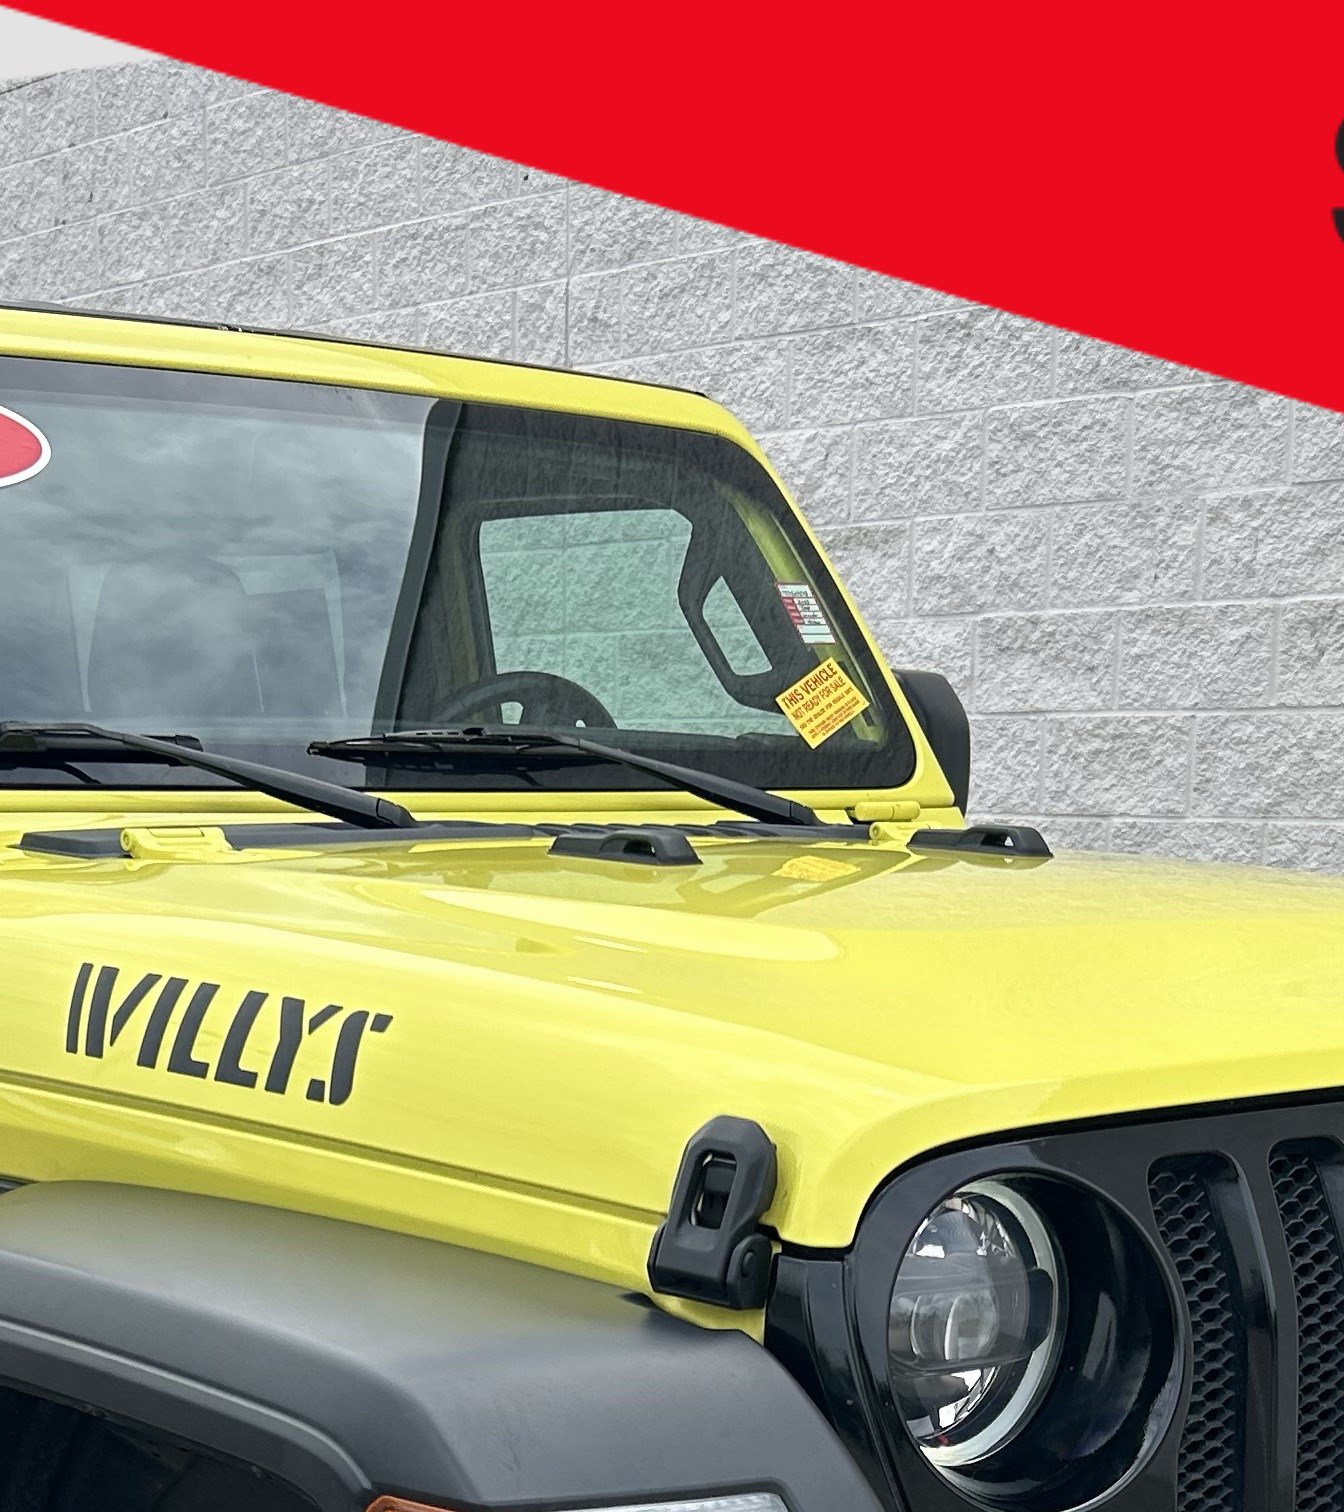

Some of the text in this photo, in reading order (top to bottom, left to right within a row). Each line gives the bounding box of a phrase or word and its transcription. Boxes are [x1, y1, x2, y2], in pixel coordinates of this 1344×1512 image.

[781, 688, 805, 709] THIS
[799, 662, 838, 695] VEHICLE
[818, 685, 834, 700] FOR
[829, 675, 847, 692] SALE
[65, 962, 394, 1106] WILLYS
